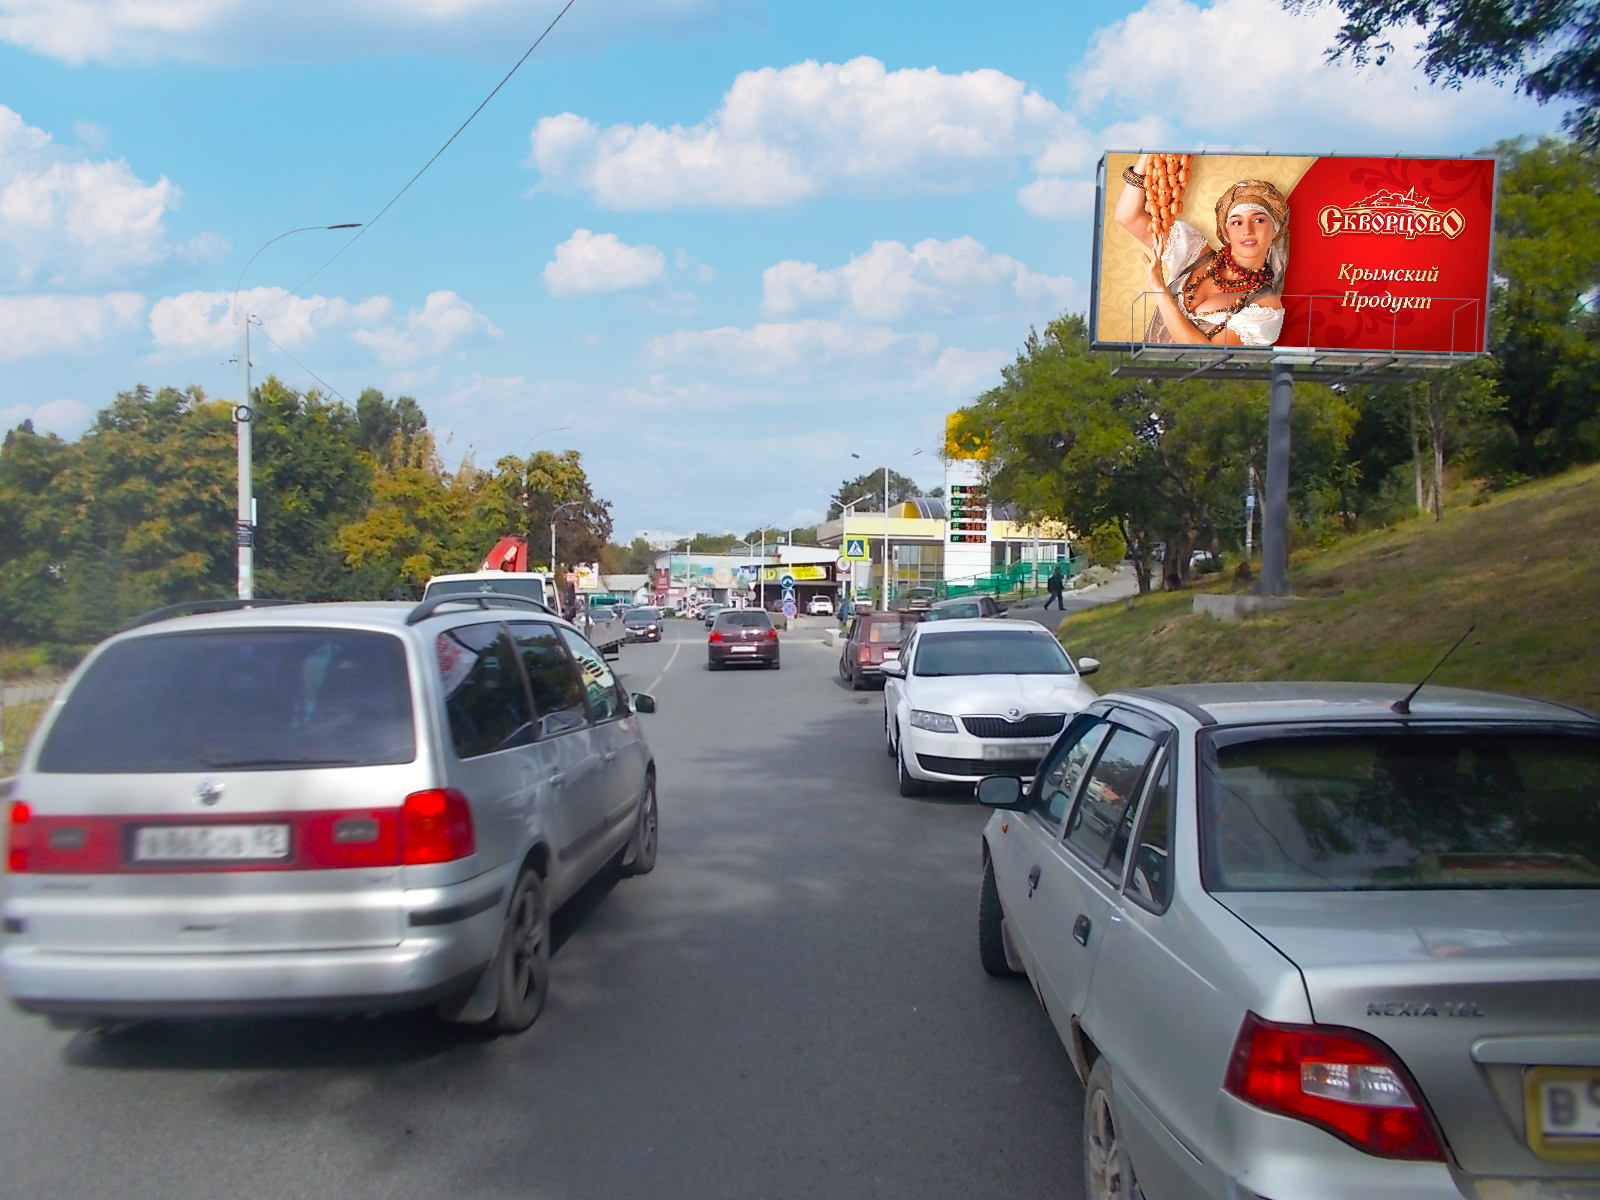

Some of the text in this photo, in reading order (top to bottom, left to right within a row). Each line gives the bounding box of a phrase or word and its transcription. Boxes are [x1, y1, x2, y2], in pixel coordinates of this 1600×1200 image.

[1337, 263, 1440, 286] Крымский
[1340, 290, 1432, 313] Продукт
[1366, 1001, 1438, 1017] NEXIA
